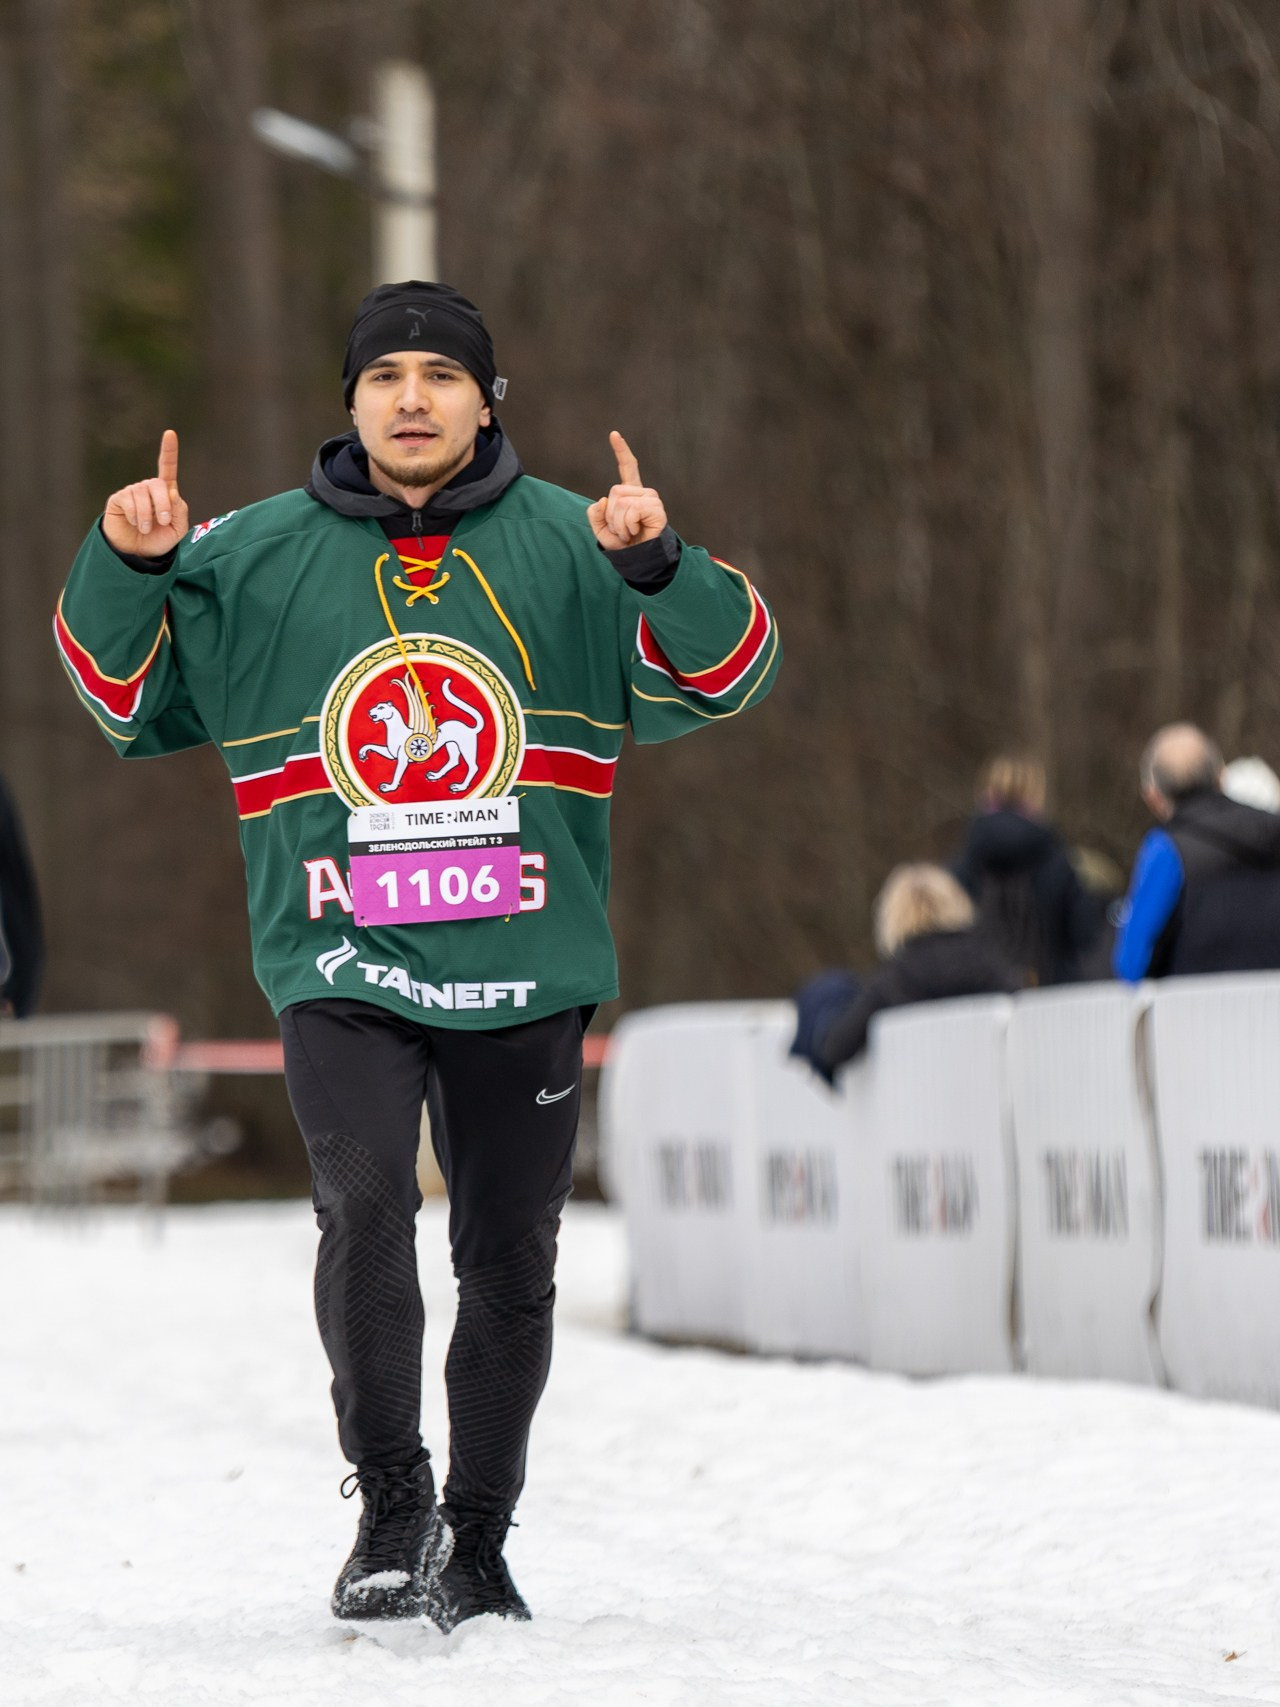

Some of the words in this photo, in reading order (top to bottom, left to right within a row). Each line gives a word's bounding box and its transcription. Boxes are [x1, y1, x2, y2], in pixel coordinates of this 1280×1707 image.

[368, 838, 456, 853] ЗЕЛЕНОДОЛЬСКИЙ
[457, 836, 487, 847] ТРЕЙЛ
[375, 864, 501, 909] 1106
